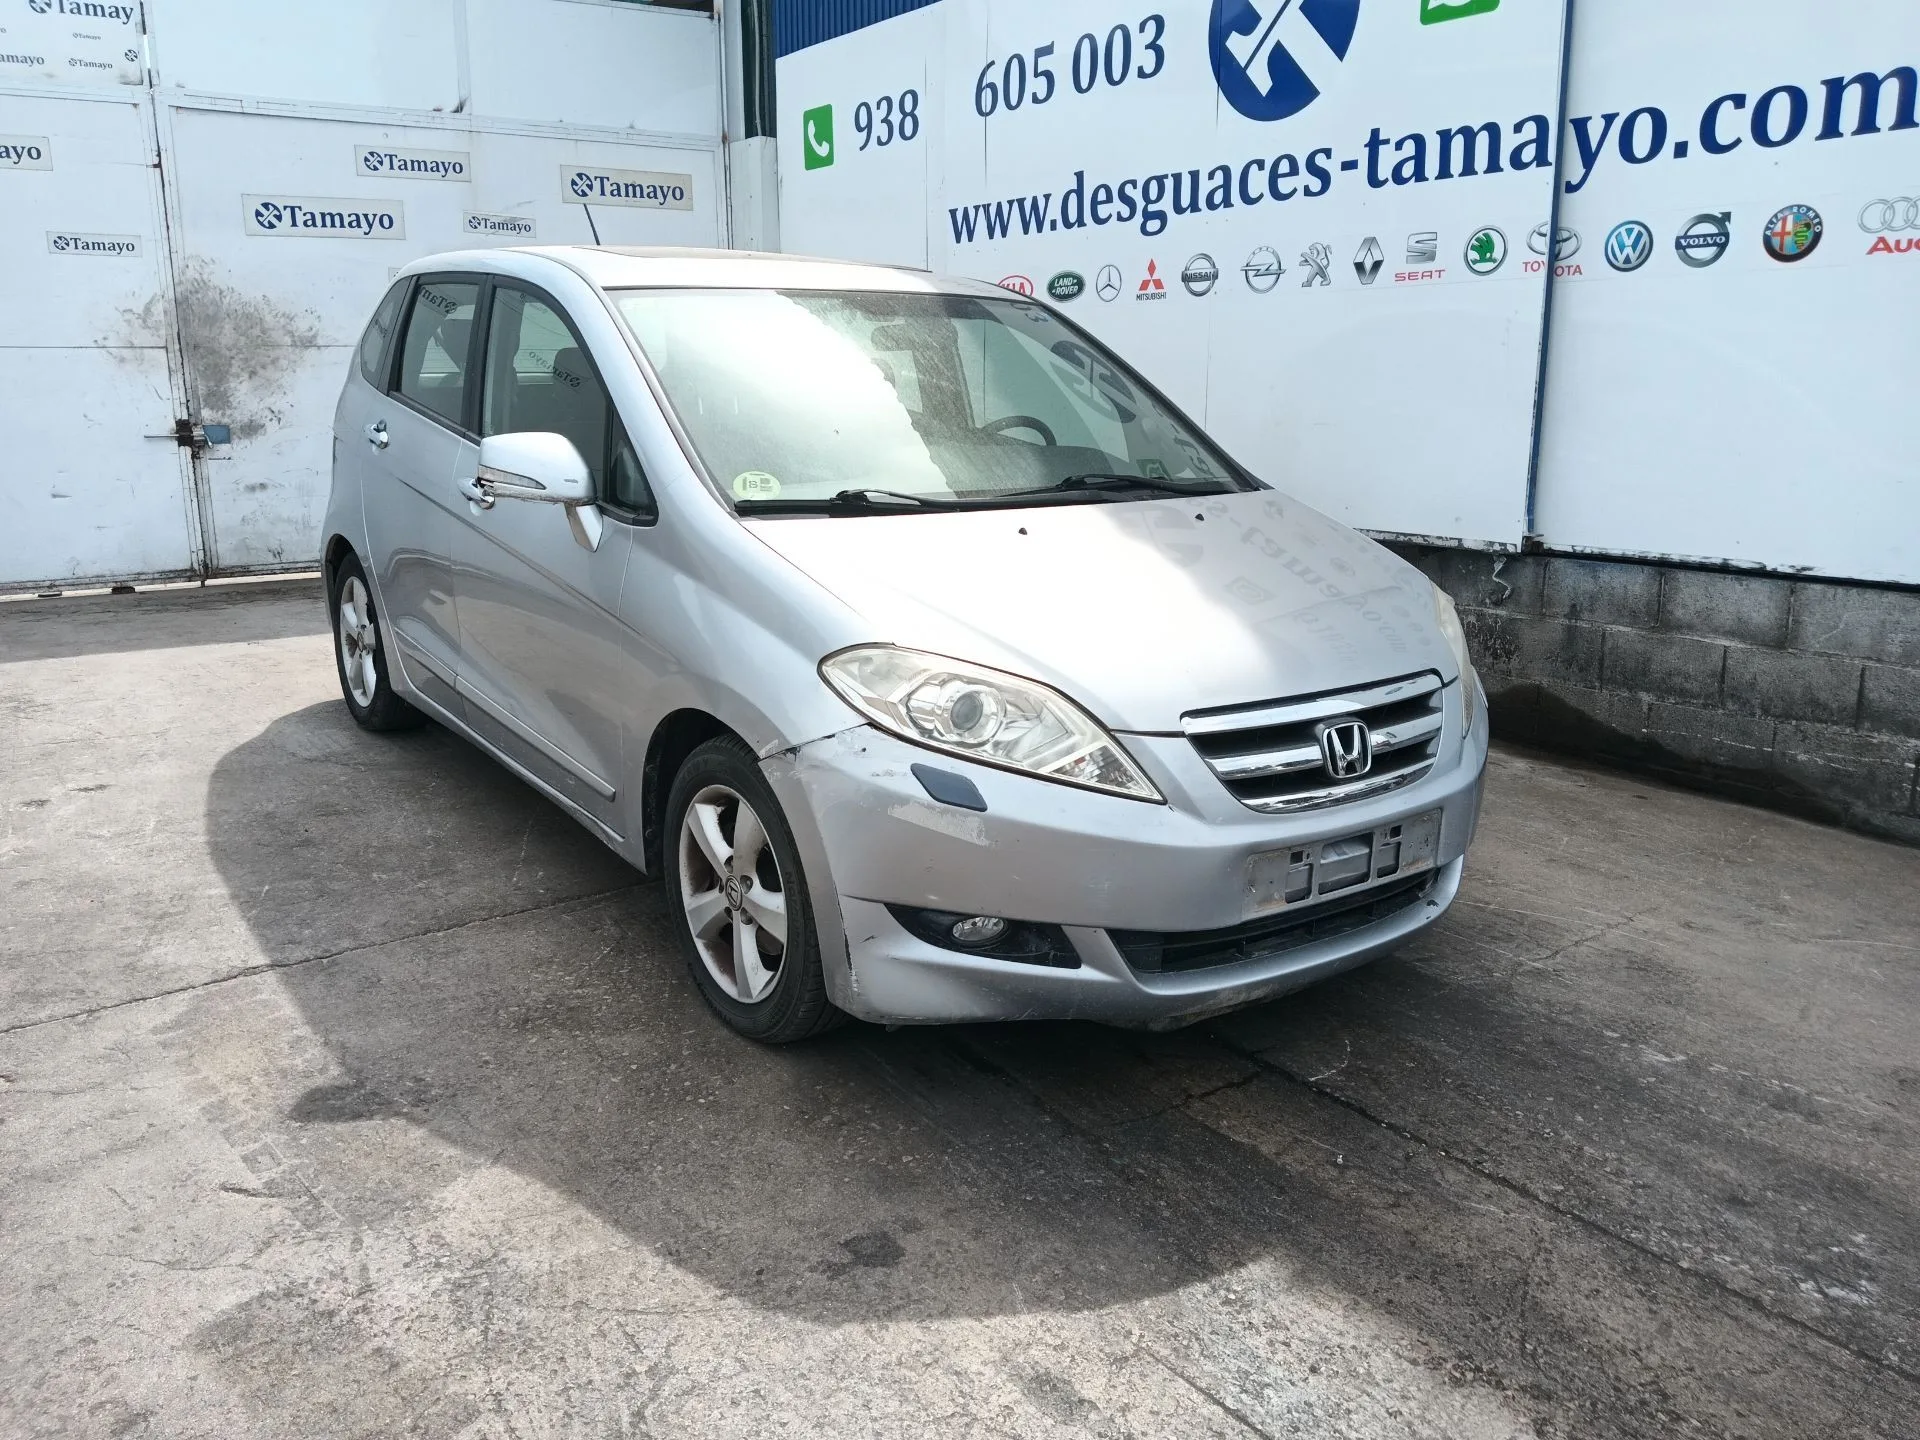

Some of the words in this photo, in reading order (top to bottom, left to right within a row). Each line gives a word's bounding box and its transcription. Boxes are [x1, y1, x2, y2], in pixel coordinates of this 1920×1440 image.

[76, 59, 113, 70] Tamayo
[854, 89, 919, 151] 938
[974, 40, 1056, 117] 605
[1072, 14, 1165, 94] 003
[383, 153, 464, 178] Tamayo
[948, 66, 1920, 244] www.desguaces-tamayo.com
[594, 176, 685, 205] Tamayo
[283, 205, 394, 235] Tamayo
[481, 217, 532, 234] Tamayo
[1764, 211, 1785, 236] ALFA
[1792, 205, 1822, 233] ROMEO
[69, 237, 136, 255] Tamayo
[1679, 235, 1726, 247] VOLVO
[1394, 268, 1446, 282] SEAT
[1136, 291, 1167, 301] MITSUBISHI
